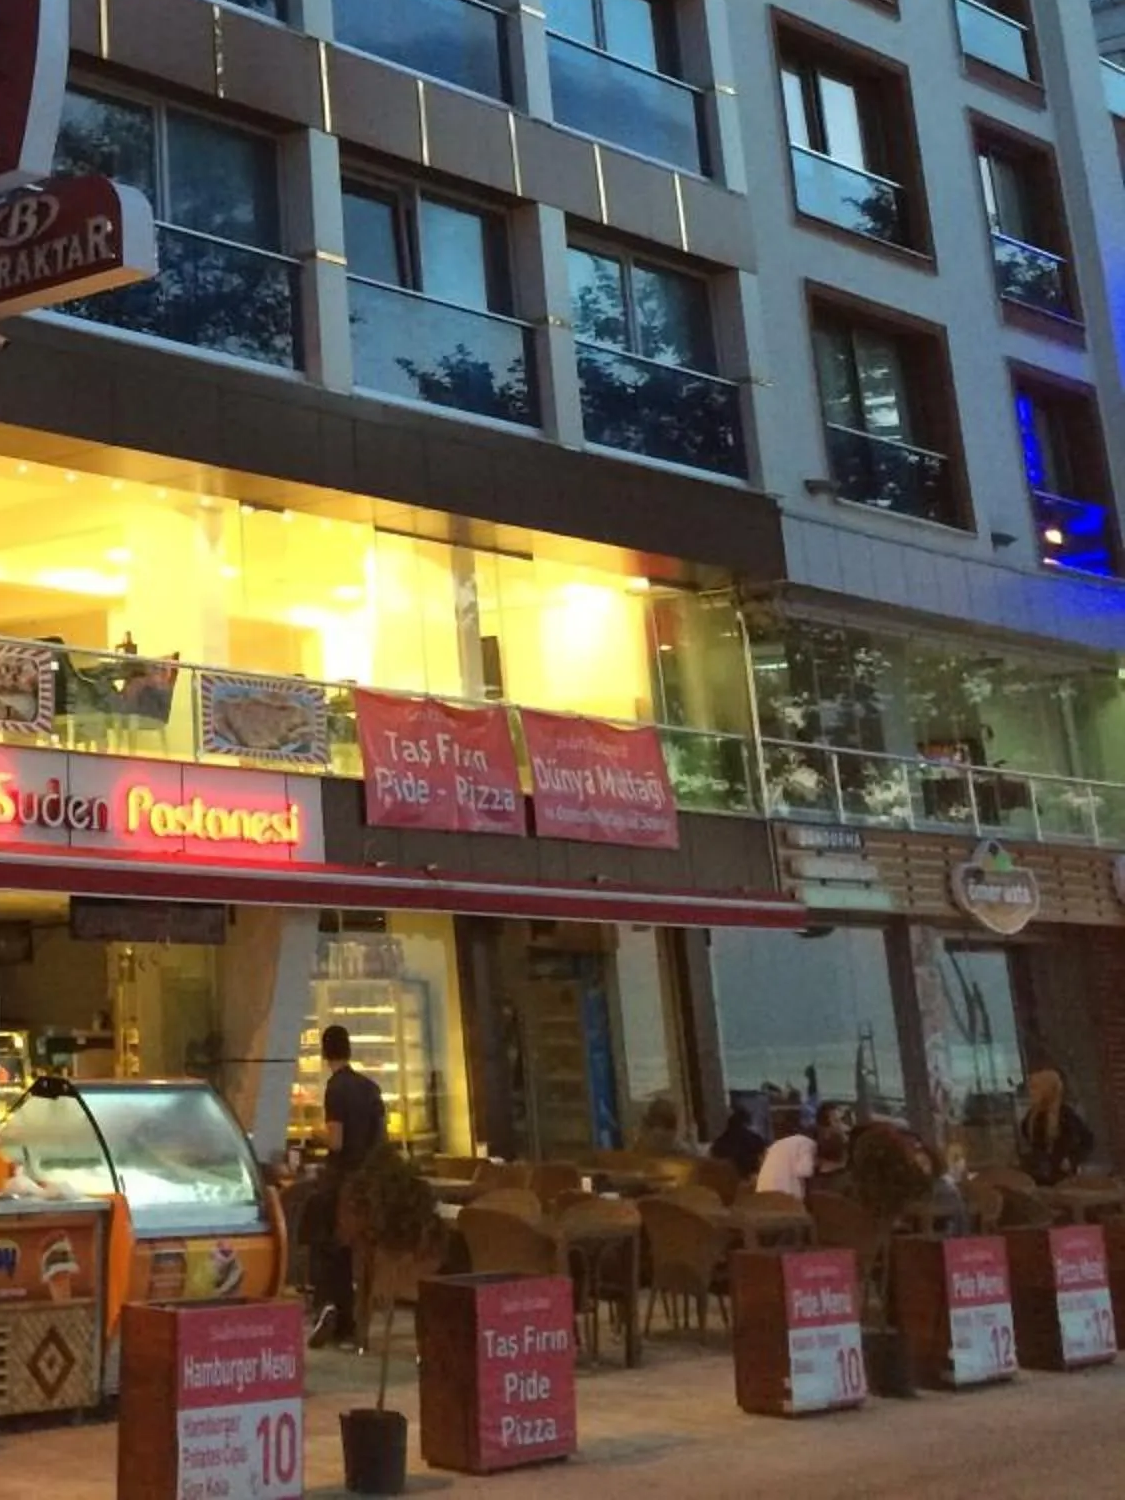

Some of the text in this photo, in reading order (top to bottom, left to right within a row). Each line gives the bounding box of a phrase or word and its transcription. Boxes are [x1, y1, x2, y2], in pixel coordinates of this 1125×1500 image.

[375, 767, 430, 804] Pide
[455, 775, 516, 812] Pizza
[532, 755, 596, 801] Dünya
[126, 785, 299, 844] Pastanesi
[483, 1325, 568, 1360] Taş Fırın
[991, 1325, 1013, 1369] 12
[183, 1345, 297, 1394] Hamburger Menü
[504, 1369, 551, 1404] Pide
[837, 1346, 863, 1397] 10
[256, 1411, 297, 1487] 10
[501, 1415, 557, 1448] Pizza
